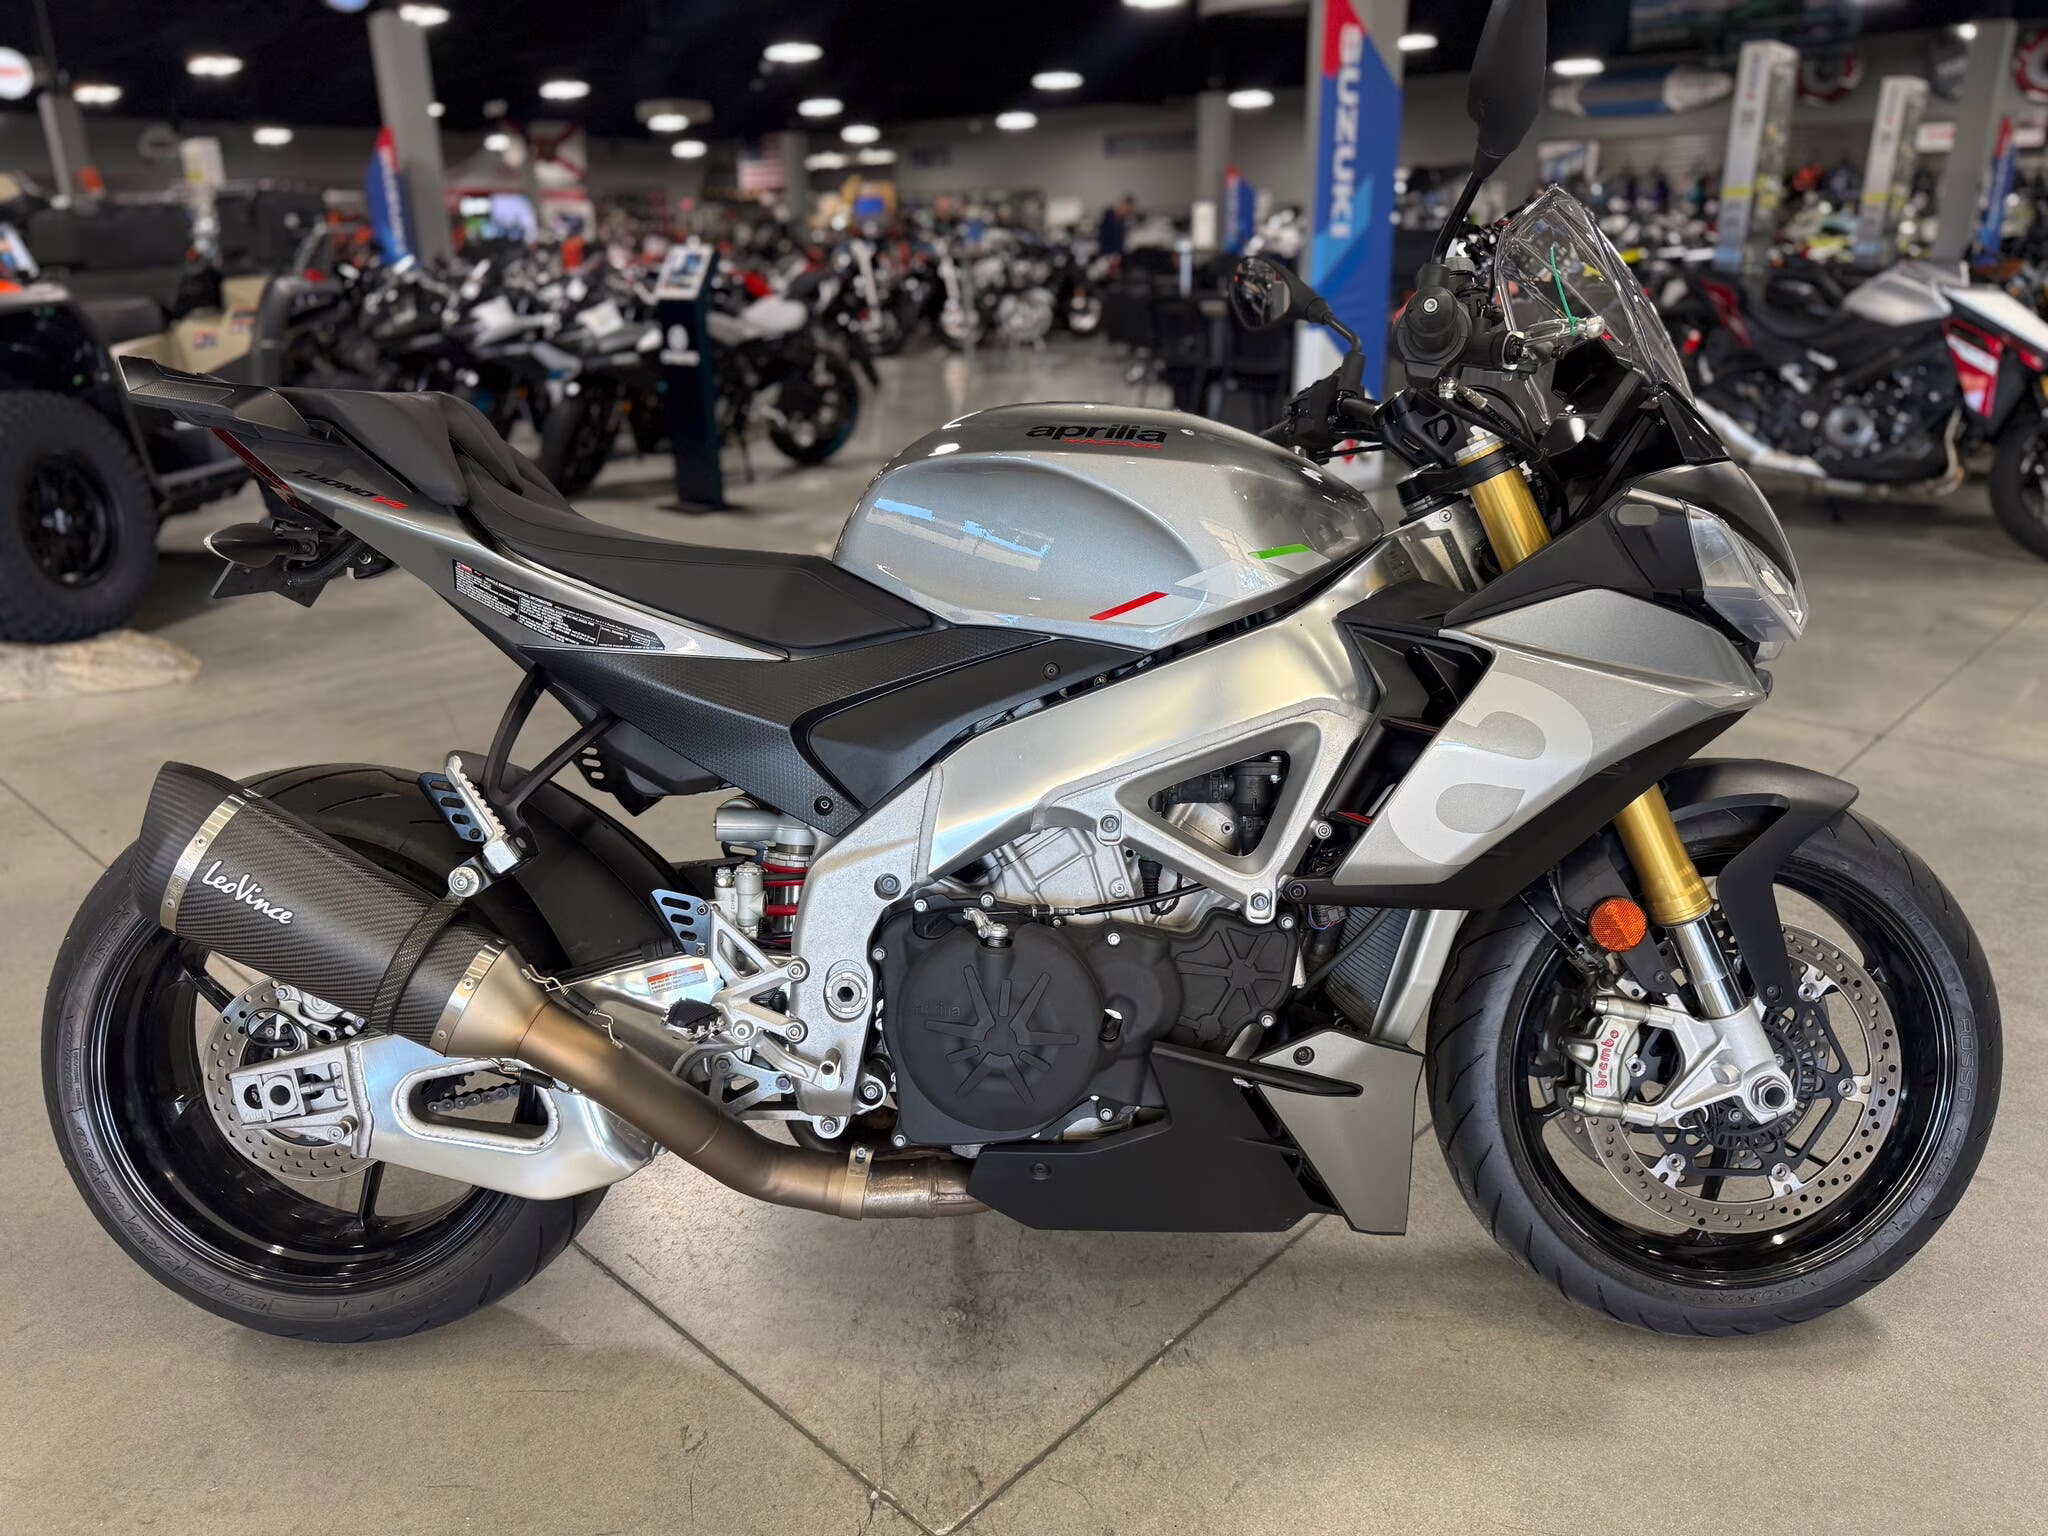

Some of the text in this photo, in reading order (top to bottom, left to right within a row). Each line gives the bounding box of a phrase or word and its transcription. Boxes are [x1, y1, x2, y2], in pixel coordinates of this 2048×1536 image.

[1329, 23, 1363, 238] SUZUKI
[1025, 424, 1168, 443] aprilia
[292, 468, 378, 497] TUONO
[202, 860, 294, 924] LeoVince
[1594, 1030, 1619, 1089] brembo
[1957, 1017, 1975, 1104] ROSSO
